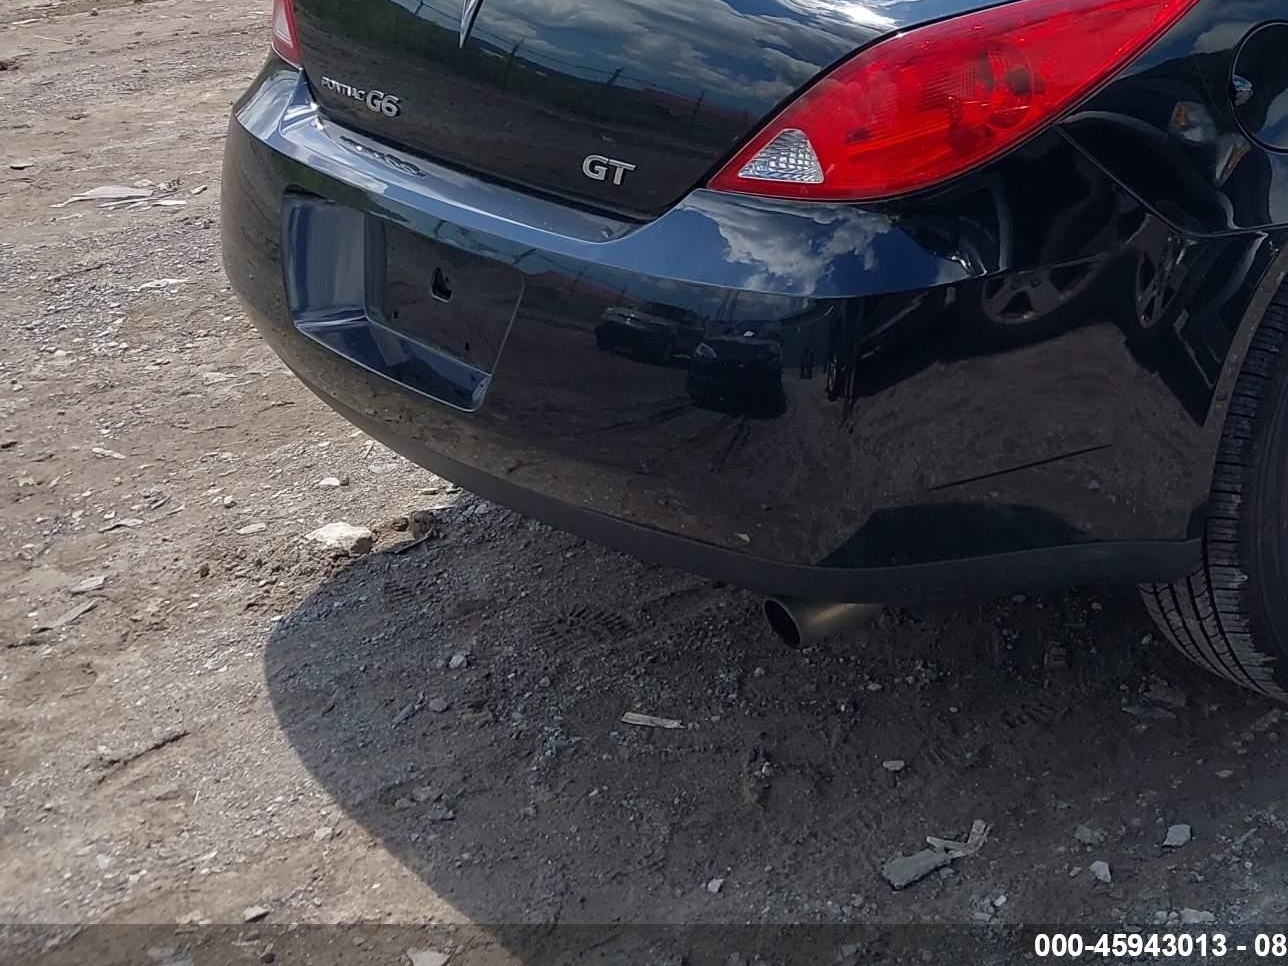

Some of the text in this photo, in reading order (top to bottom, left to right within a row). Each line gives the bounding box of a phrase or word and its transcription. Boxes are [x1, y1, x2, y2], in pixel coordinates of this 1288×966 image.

[321, 76, 400, 117] PONTIAC G6
[583, 154, 636, 185] GT
